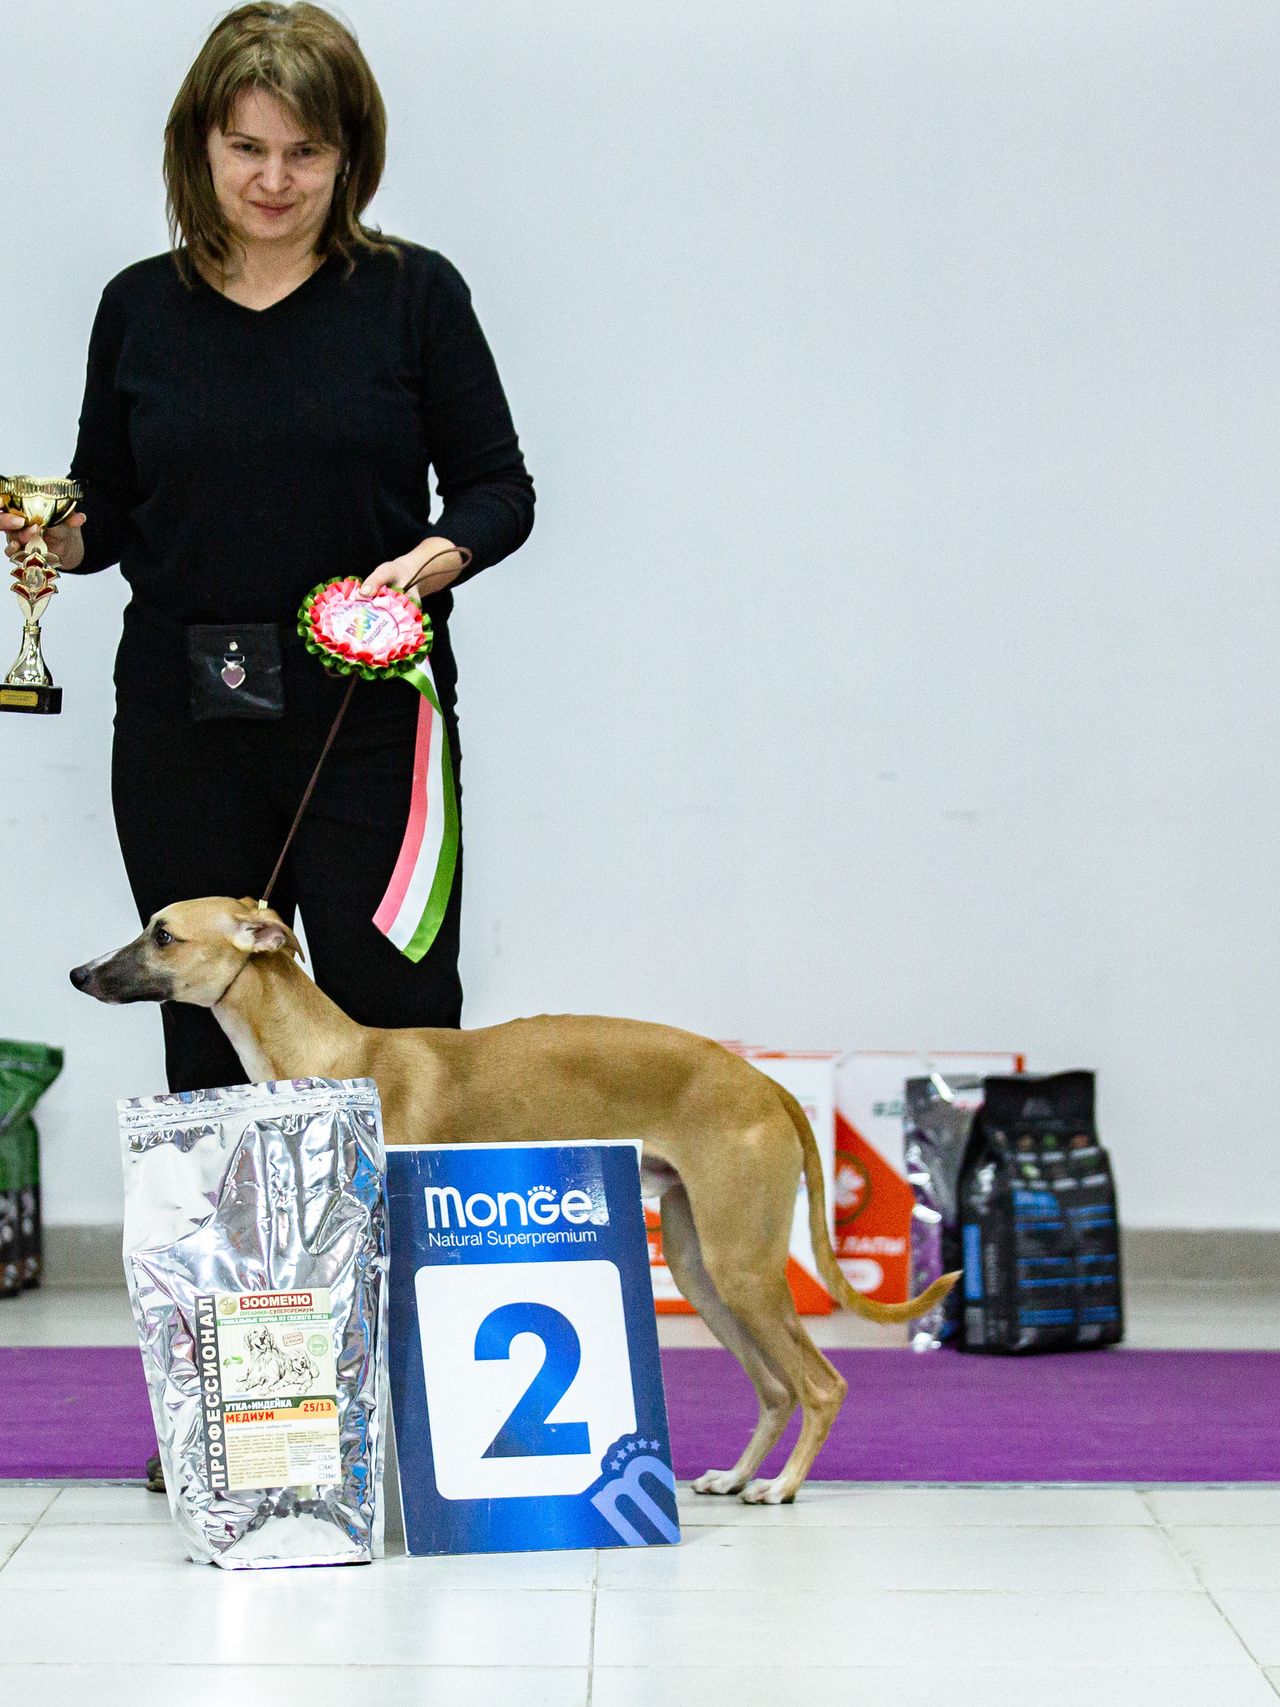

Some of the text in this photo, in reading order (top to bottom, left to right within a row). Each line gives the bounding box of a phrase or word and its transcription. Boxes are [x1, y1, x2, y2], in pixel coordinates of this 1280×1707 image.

[428, 1229, 597, 1248] Natural Superpremium
[241, 1295, 311, 1309] ЗООМЕНЮ
[220, 1317, 258, 1326] УНИКАЛЬНЫЕ
[259, 1315, 278, 1323] КОРМА
[287, 1313, 311, 1321] СВЕЖЕГО
[474, 1302, 591, 1459] 2
[198, 1297, 226, 1488] ПРОФЕССИОНАЛ
[303, 1402, 332, 1413] 25/13
[226, 1411, 275, 1423] МЕДИУМ
